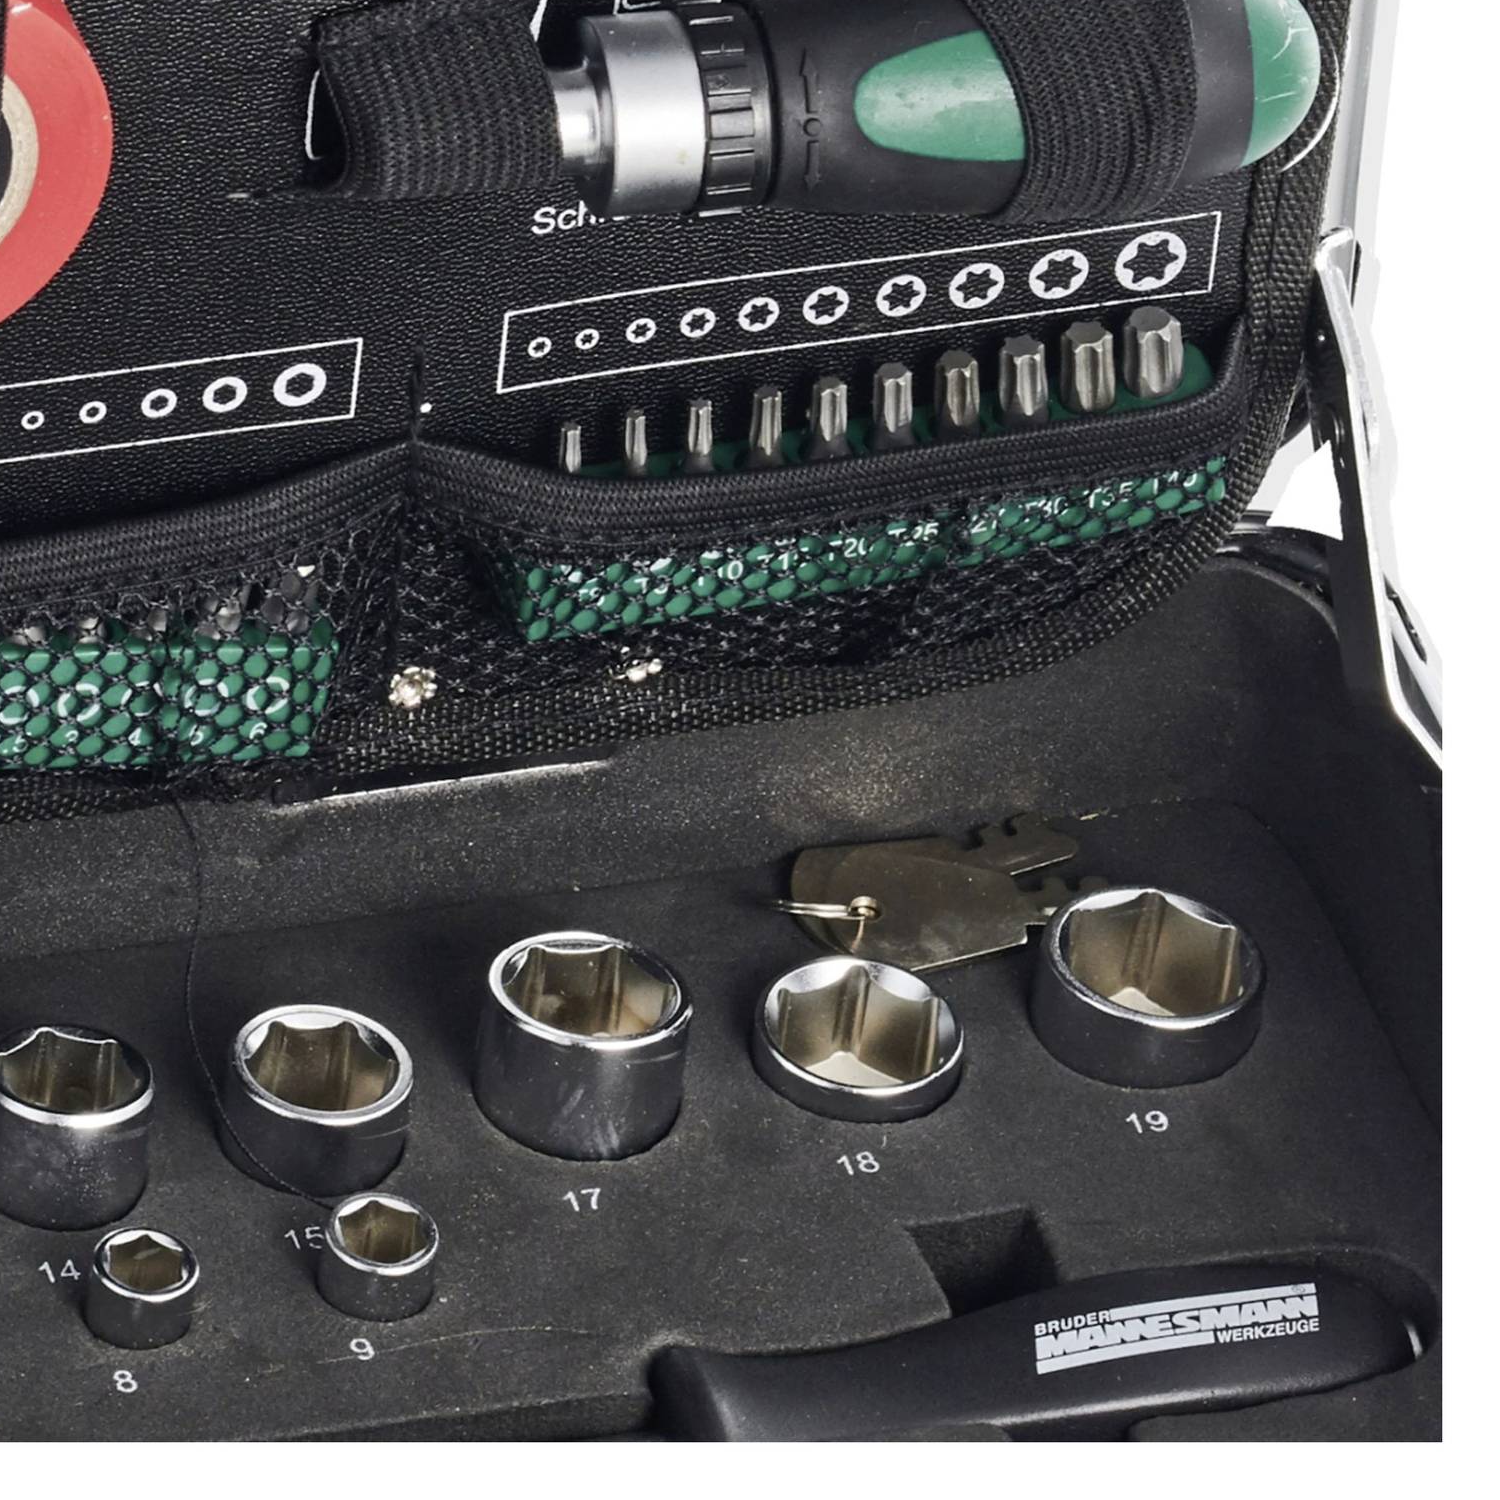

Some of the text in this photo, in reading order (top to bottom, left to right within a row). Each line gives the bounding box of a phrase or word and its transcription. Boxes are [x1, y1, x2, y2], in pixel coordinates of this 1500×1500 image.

[1126, 1110, 1169, 1134] 19
[836, 1151, 880, 1176] 18
[563, 1187, 601, 1212] 17
[284, 1226, 325, 1249] 15
[38, 1259, 81, 1283] 14
[1034, 1310, 1111, 1336] BRUDER
[1035, 1294, 1319, 1360] MANNESMANN
[1217, 1317, 1320, 1344] WERKZEUGE
[350, 1336, 376, 1360] 9
[113, 1370, 138, 1393] 8
